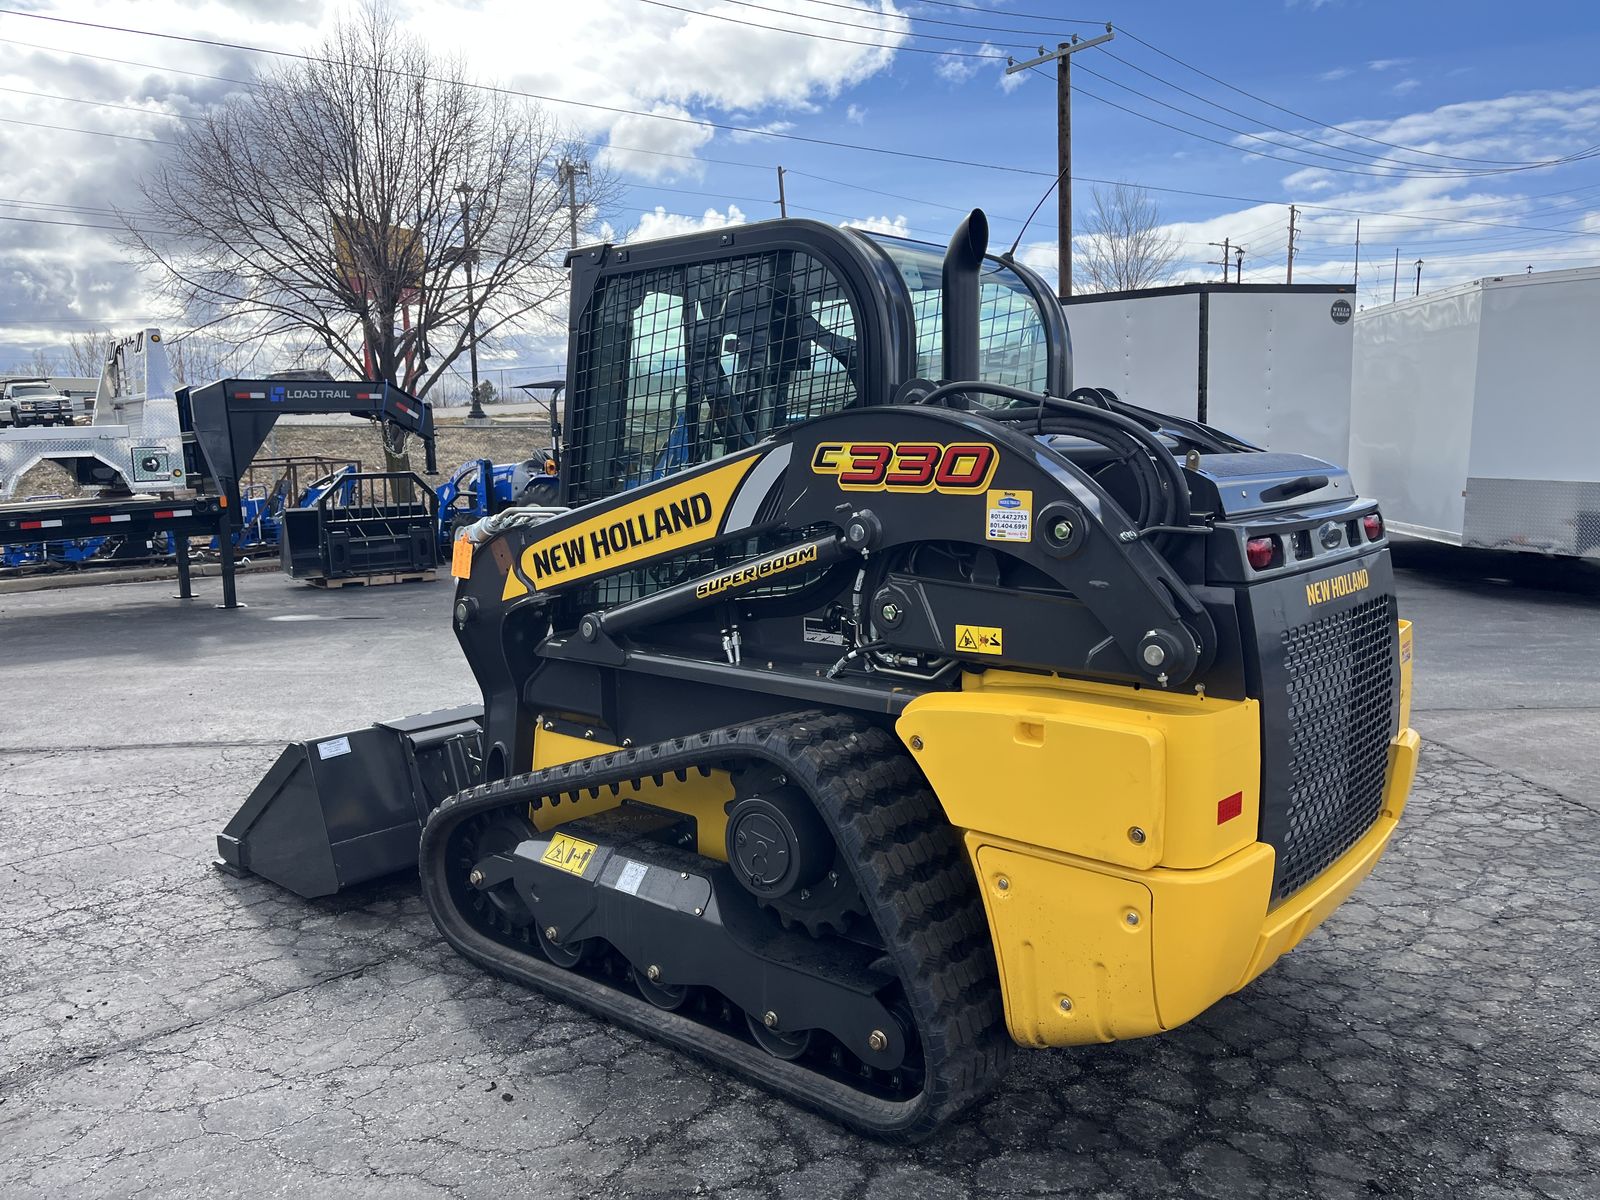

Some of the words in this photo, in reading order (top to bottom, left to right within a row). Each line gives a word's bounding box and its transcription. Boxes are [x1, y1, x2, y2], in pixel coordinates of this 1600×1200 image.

[287, 390, 317, 399] LOAD
[320, 390, 351, 399] TRAIL
[812, 443, 998, 491] C330
[532, 535, 587, 581] NEW
[589, 491, 713, 562] HOLLAND
[697, 565, 758, 599] SUPER
[758, 543, 818, 579] BOOM
[1306, 579, 1331, 606] NEW
[1330, 568, 1369, 599] HOLLAND
